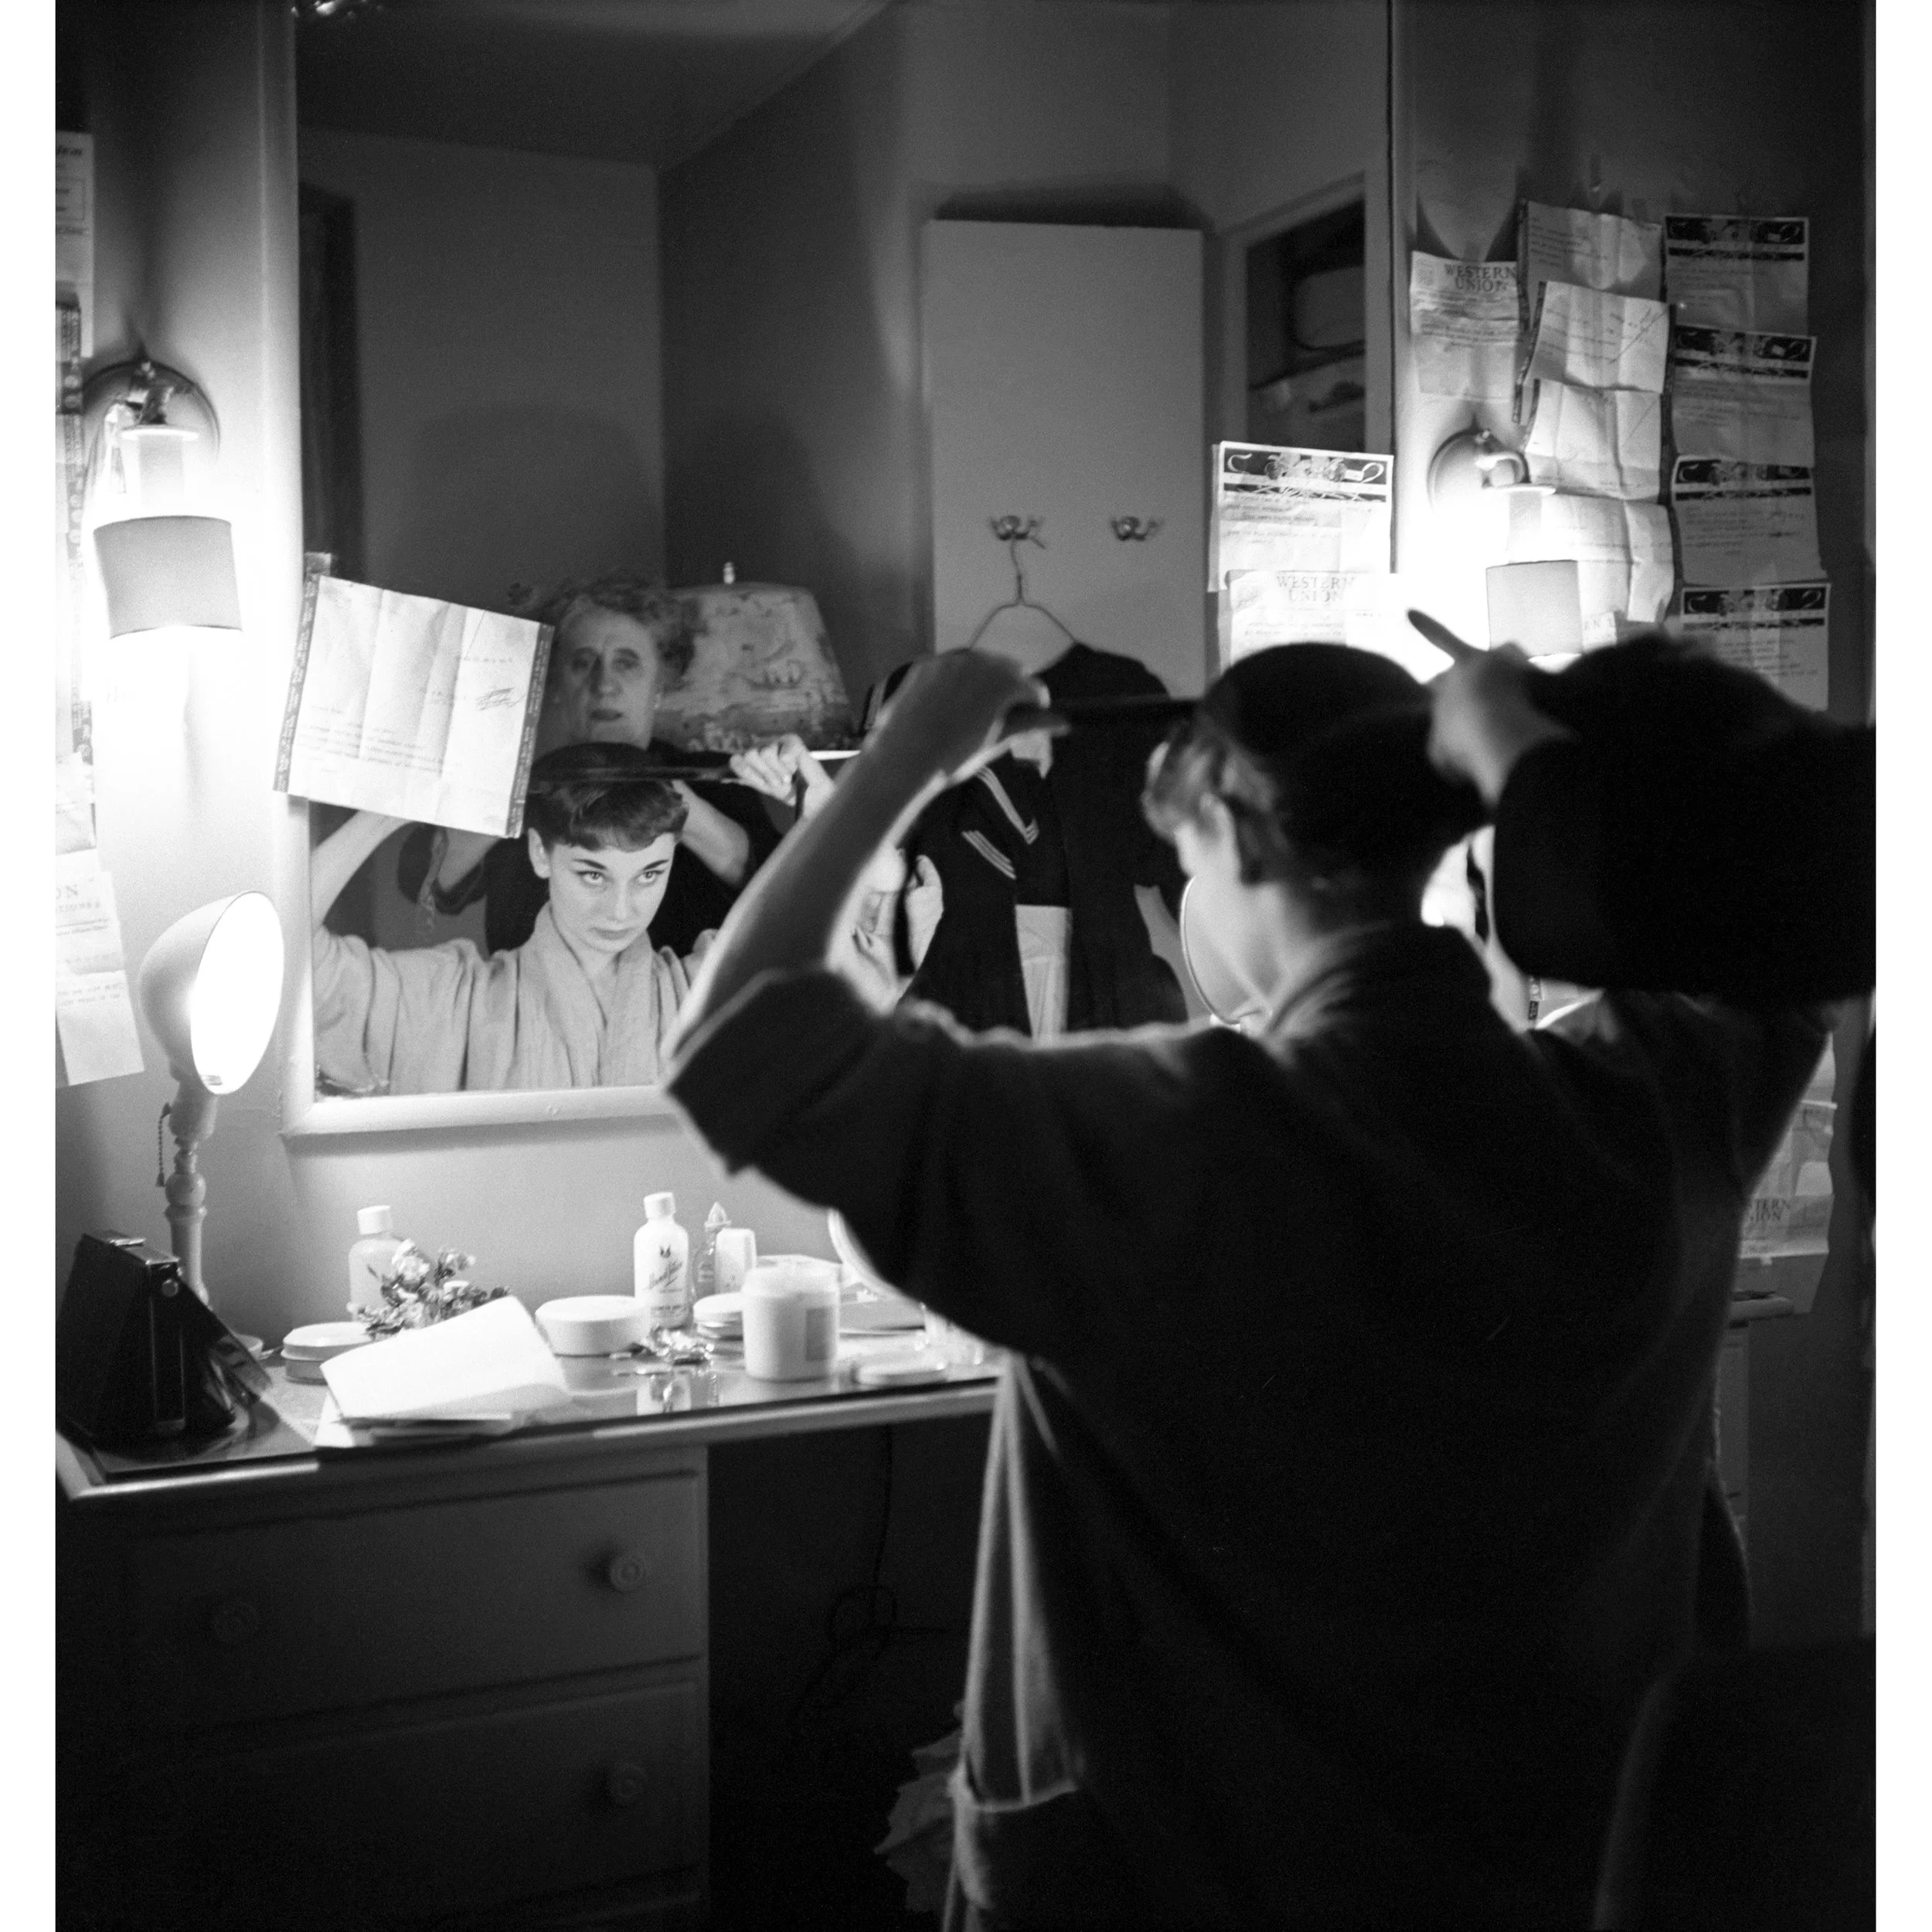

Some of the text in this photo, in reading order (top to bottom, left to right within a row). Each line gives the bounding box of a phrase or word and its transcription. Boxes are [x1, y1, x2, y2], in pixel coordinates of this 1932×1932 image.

[1444, 264, 1517, 279] WESTERN
[1455, 277, 1509, 292] UNION
[1277, 576, 1355, 590] WESTERN
[1288, 589, 1344, 603] UNION
[1753, 1198, 1791, 1210] TERN
